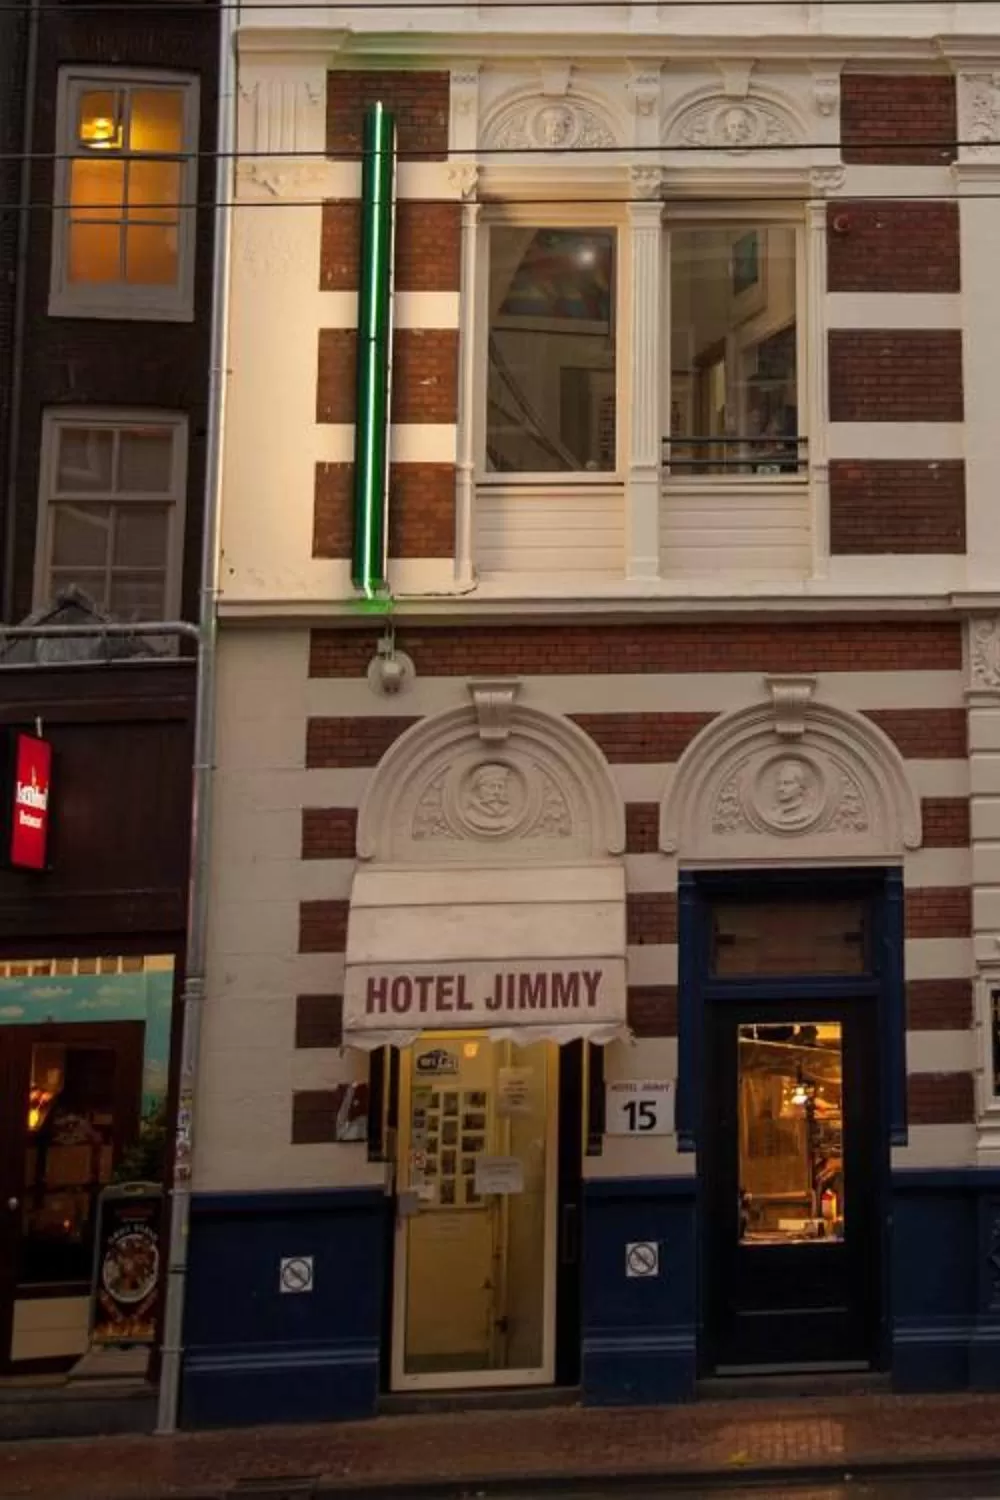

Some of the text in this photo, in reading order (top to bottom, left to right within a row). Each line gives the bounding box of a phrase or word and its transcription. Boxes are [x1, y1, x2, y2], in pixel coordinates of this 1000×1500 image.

[366, 971, 602, 1014] HOTEL JIMMY
[623, 1100, 657, 1131] 15
